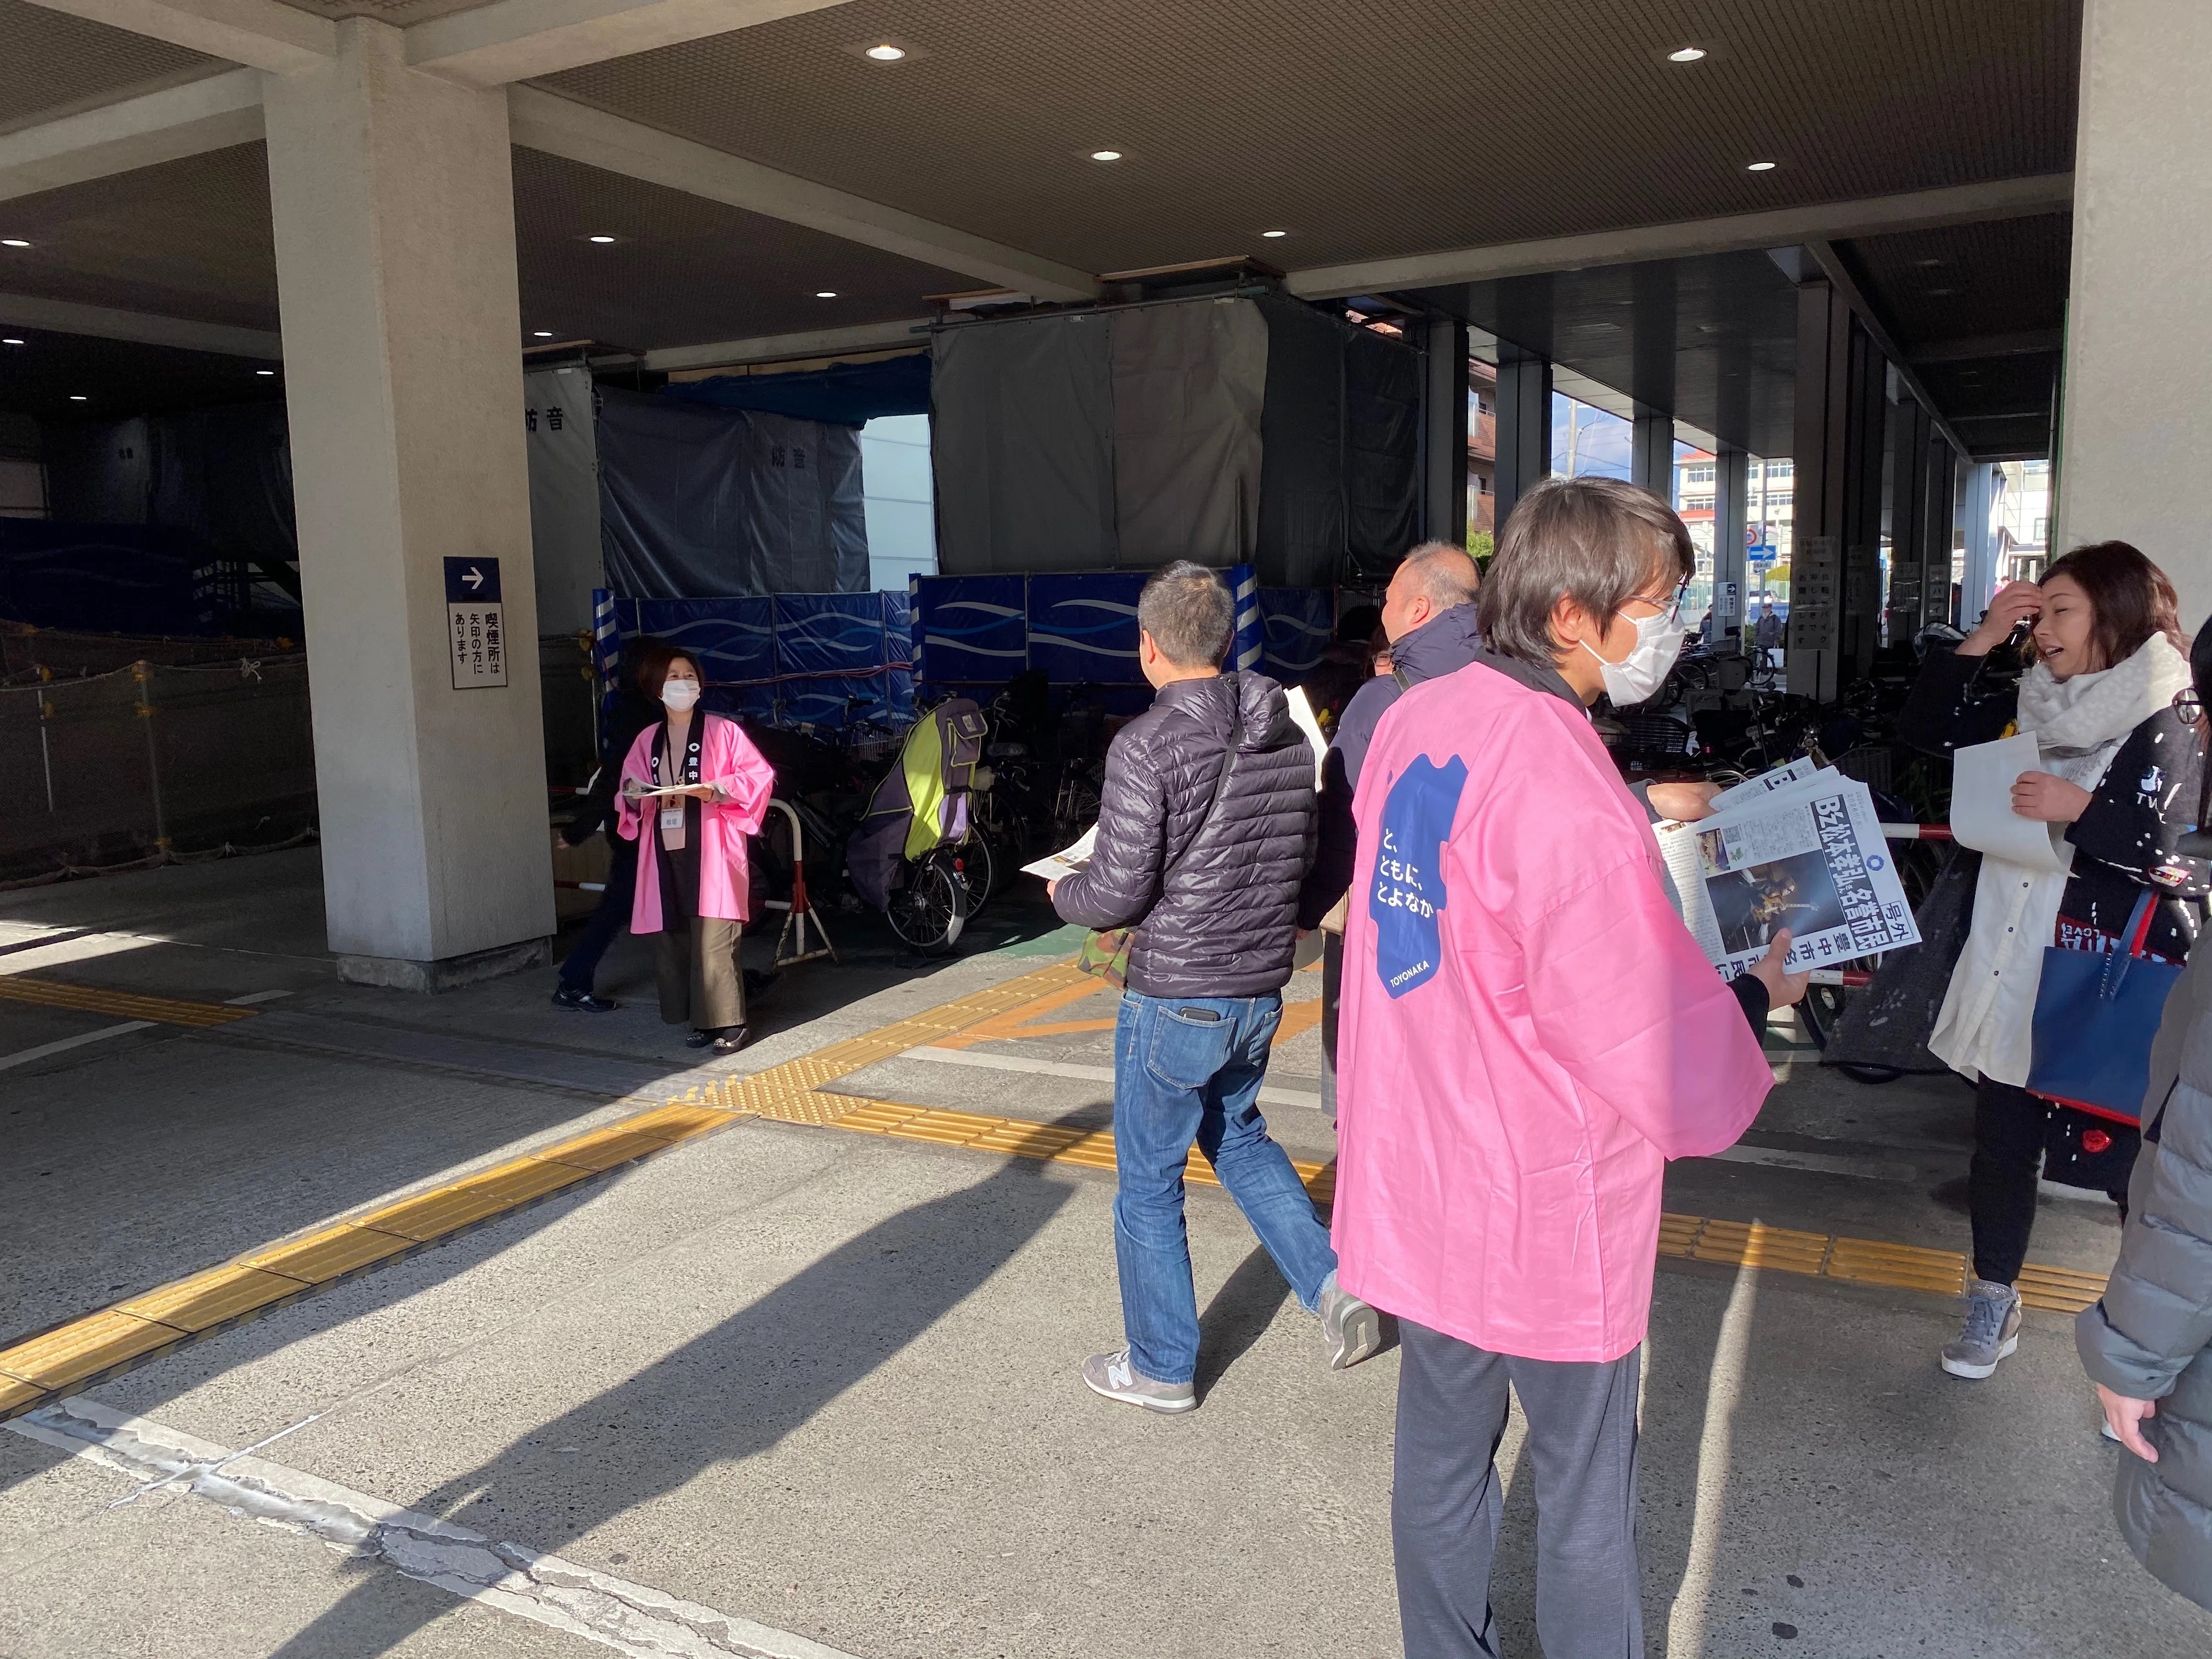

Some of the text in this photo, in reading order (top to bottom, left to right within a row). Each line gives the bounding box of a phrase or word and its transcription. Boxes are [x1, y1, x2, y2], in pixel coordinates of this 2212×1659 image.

[455, 613, 467, 664] あります
[470, 613, 484, 674] 矢印の方に
[485, 612, 500, 674] 喫煙所は
[1383, 827, 1397, 853] と、
[1380, 855, 1423, 891] ともに、
[1376, 881, 1434, 918] とよなか
[1882, 904, 1909, 941] 号外
[1390, 958, 1430, 988] TOYONAKA
[1108, 1361, 1133, 1390] N
